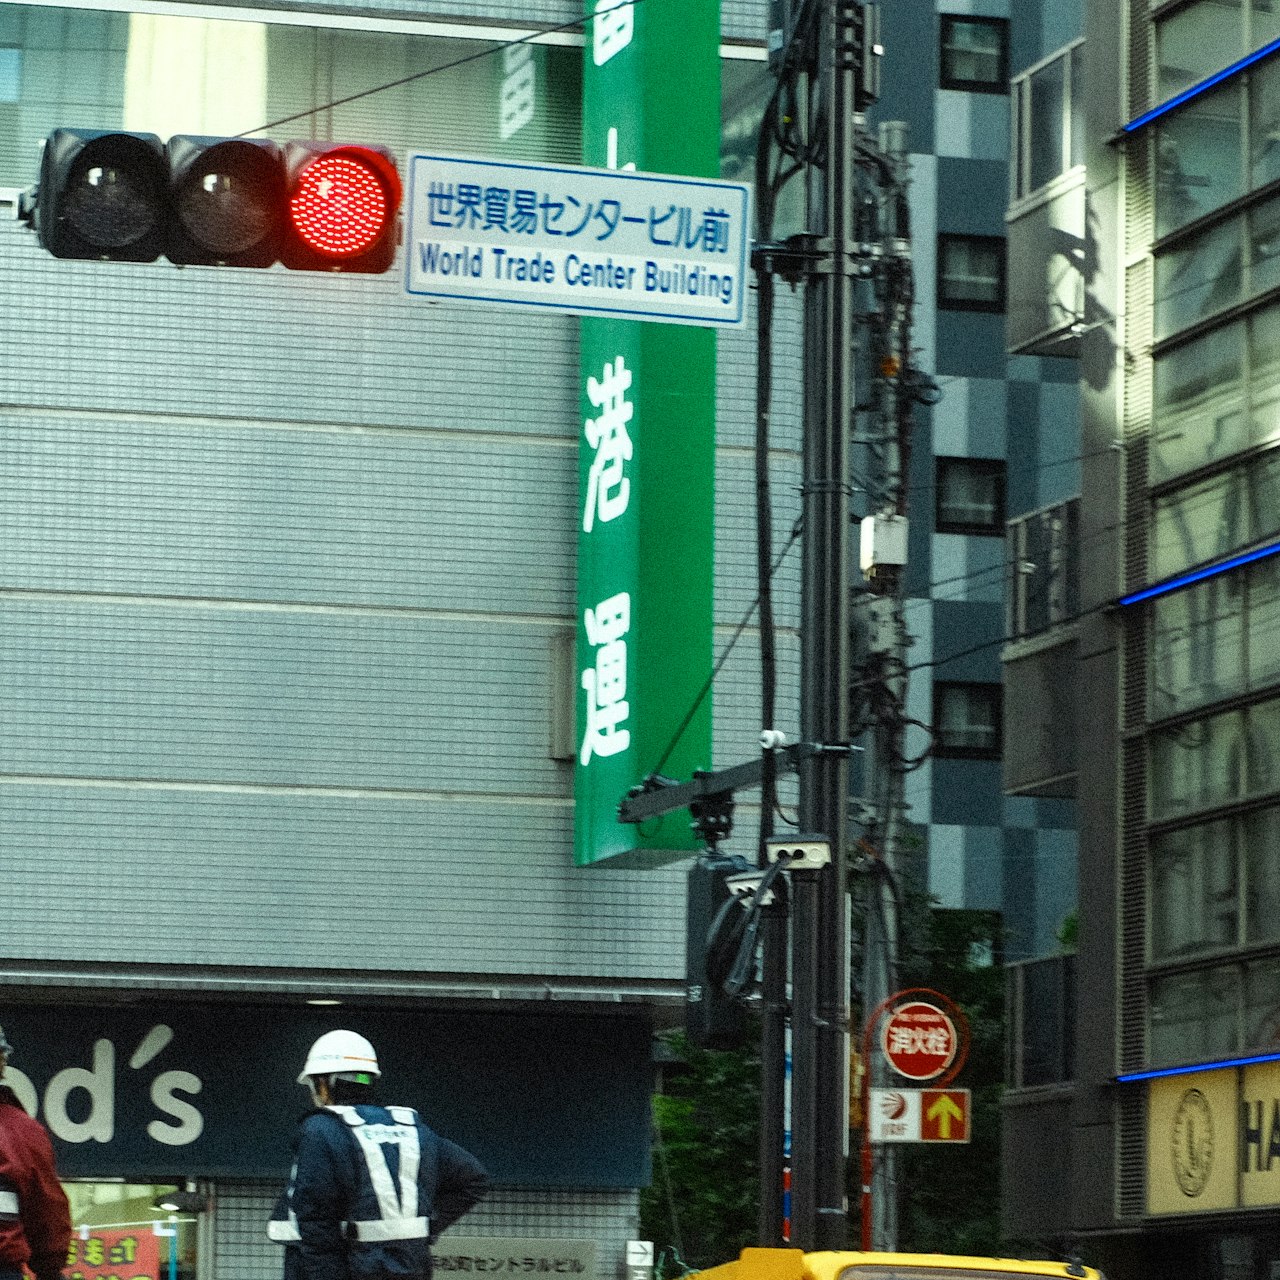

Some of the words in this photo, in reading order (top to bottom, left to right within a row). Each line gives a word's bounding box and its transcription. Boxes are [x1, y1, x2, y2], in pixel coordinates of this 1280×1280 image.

[427, 181, 730, 253] 世界貿易センタービル前
[419, 242, 483, 278] World
[491, 248, 556, 284] Trade
[563, 253, 636, 292] Center
[644, 261, 734, 305] Building
[888, 1026, 950, 1056] 消火栓
